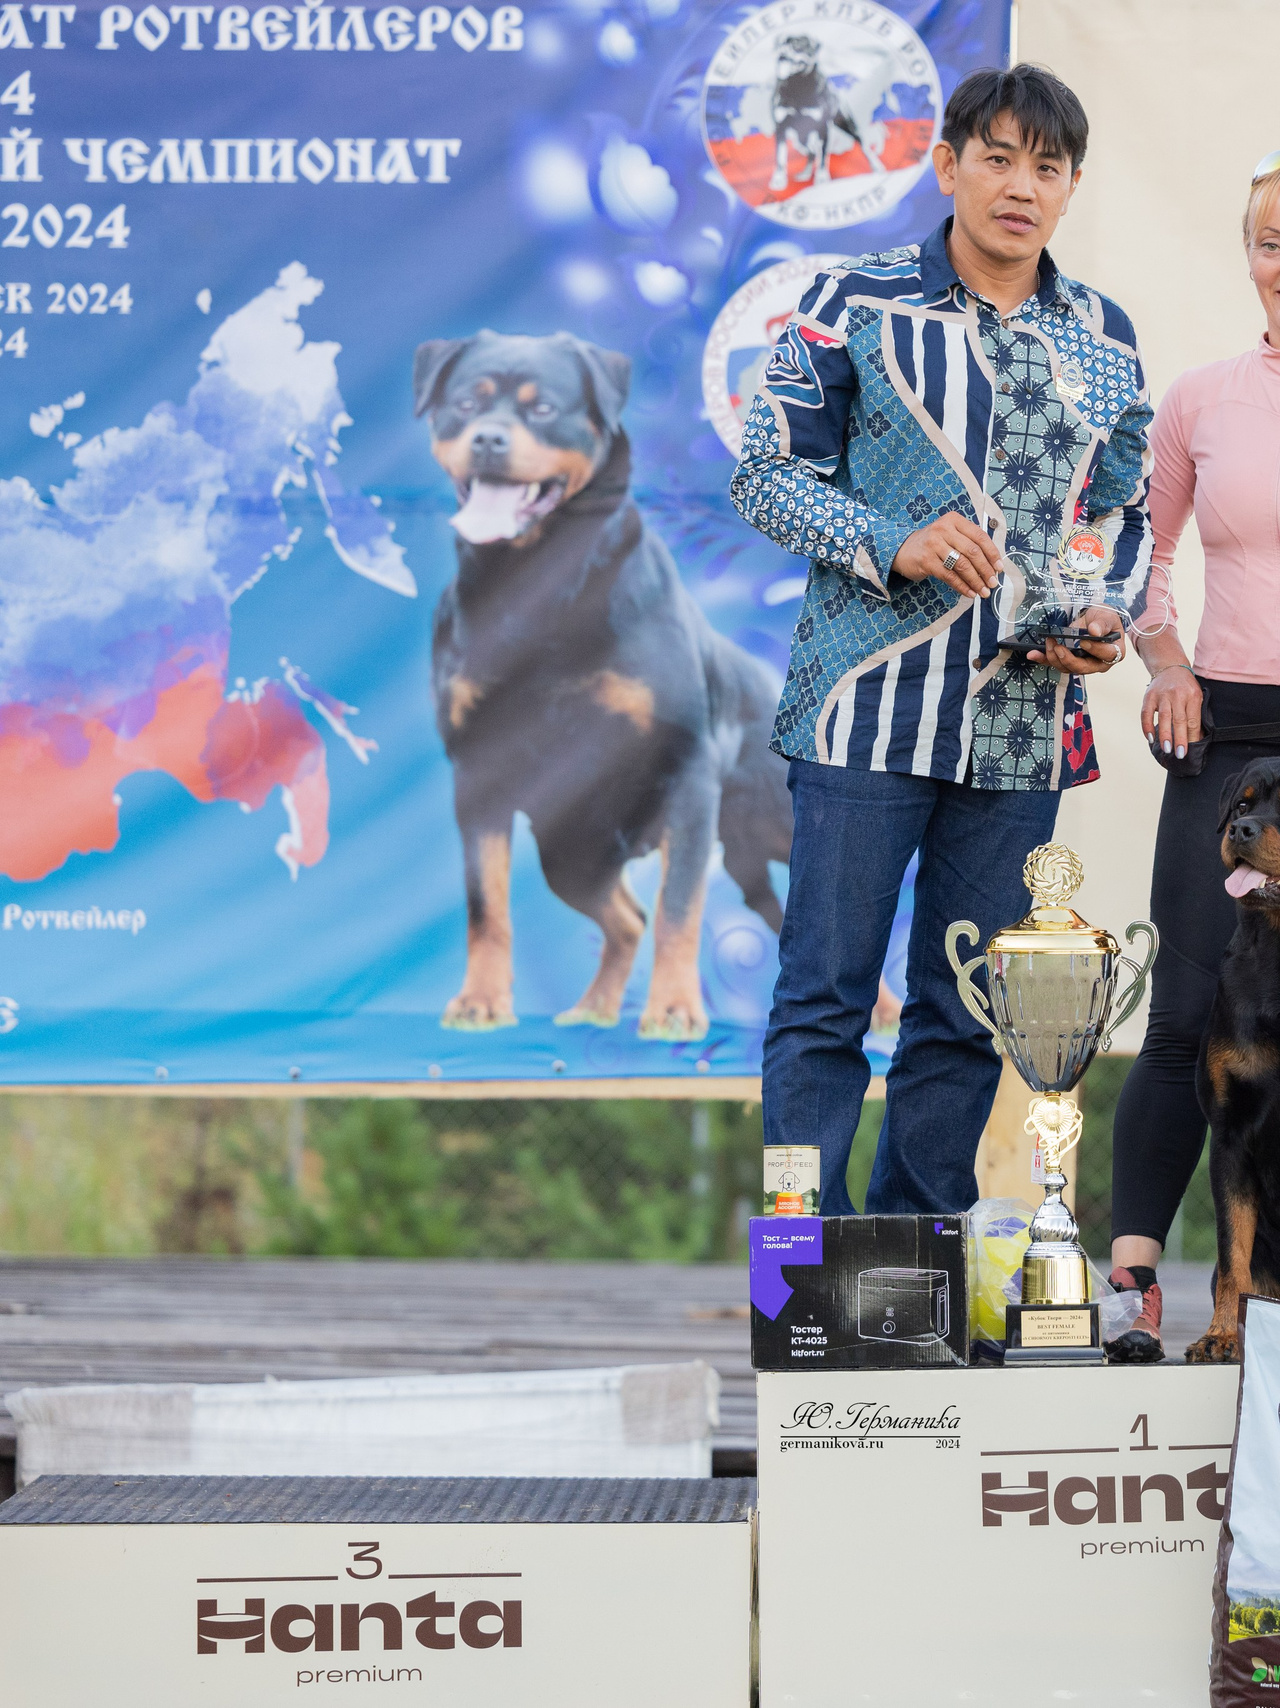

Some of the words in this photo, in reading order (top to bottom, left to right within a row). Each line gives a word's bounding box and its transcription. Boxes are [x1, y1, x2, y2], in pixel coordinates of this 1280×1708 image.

[97, 0, 524, 52] РОТВЕЙЛЕРОВ
[62, 137, 462, 184] ЧЕМПИОНАТ
[1, 203, 130, 249] 2024
[46, 281, 134, 315] 2024
[3, 903, 147, 936] Ротвейлер
[762, 1234, 780, 1242] Тост
[791, 1235, 815, 1243] всему
[791, 1325, 823, 1335] Тостер
[791, 1349, 825, 1357] kitfort.ru
[1129, 1413, 1159, 1451] 1
[981, 1461, 1230, 1527] Hant
[345, 1541, 383, 1580] 3
[1080, 1536, 1205, 1559] premium
[197, 1590, 523, 1655] Hanta
[296, 1665, 423, 1687] premium
